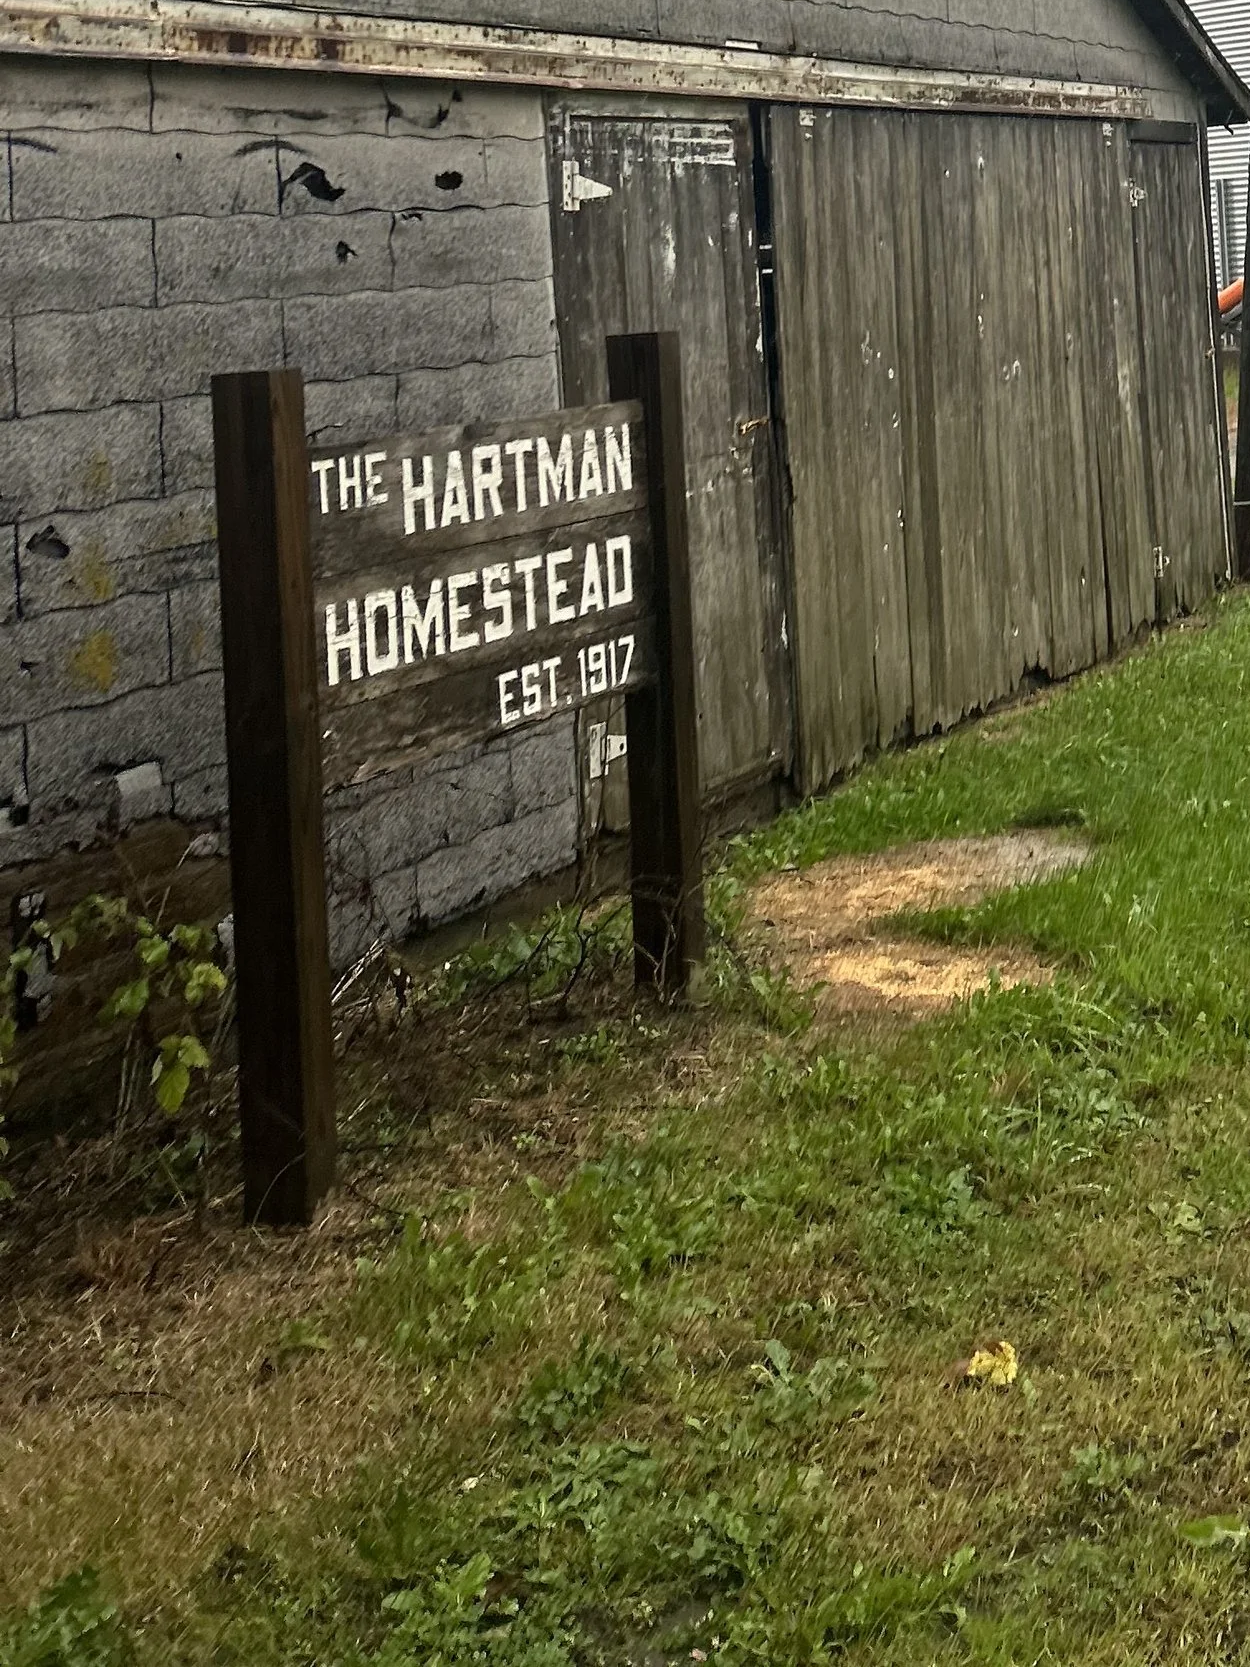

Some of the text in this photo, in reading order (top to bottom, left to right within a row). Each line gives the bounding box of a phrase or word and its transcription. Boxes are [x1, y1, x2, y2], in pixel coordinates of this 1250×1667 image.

[311, 422, 634, 535] THE HARTMAN
[325, 534, 634, 686] HOMESTEAD
[498, 634, 636, 724] EST. 1917
